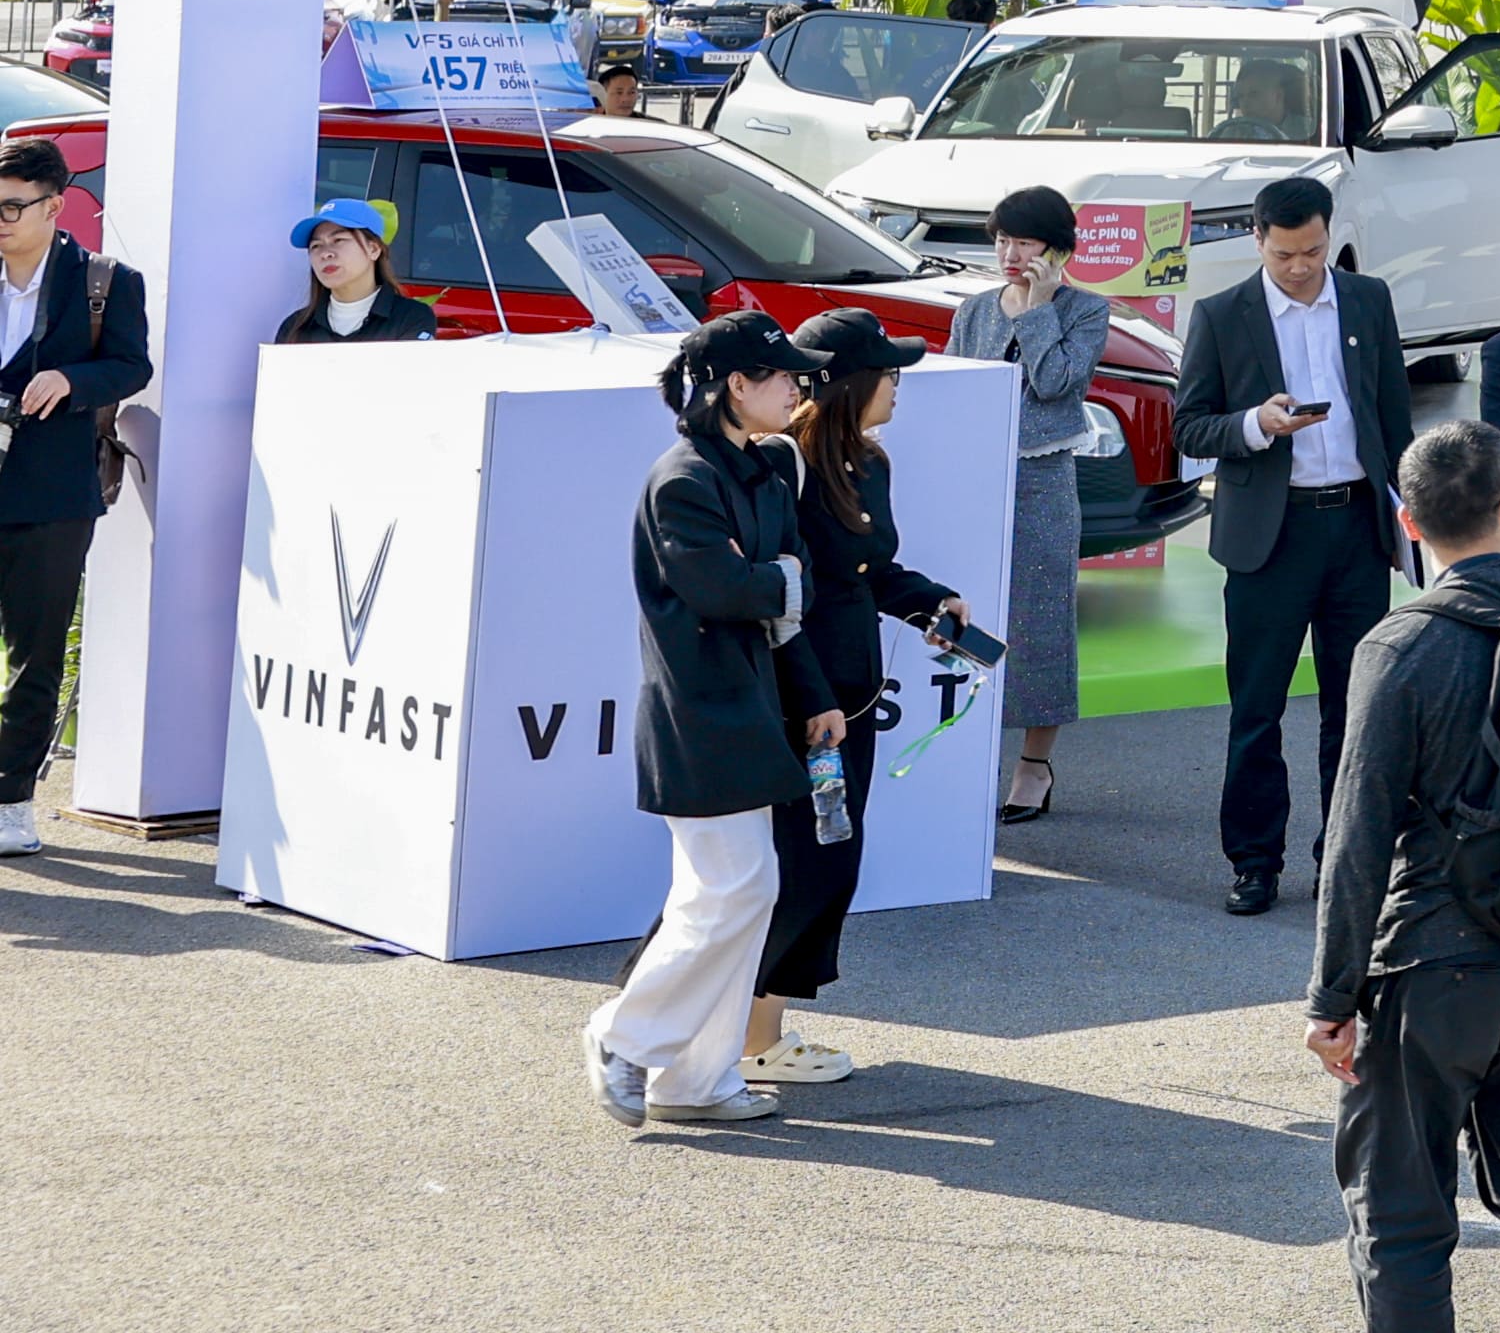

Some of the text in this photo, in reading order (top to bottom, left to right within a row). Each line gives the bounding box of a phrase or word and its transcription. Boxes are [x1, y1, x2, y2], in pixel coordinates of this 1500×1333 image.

[405, 33, 453, 49] VF5
[458, 34, 481, 48] GIÁ
[483, 34, 505, 48] CHỈ
[422, 56, 487, 91] 457
[1098, 227, 1120, 240] PIN
[253, 653, 452, 761] VINFAST
[517, 673, 970, 762] VIST
